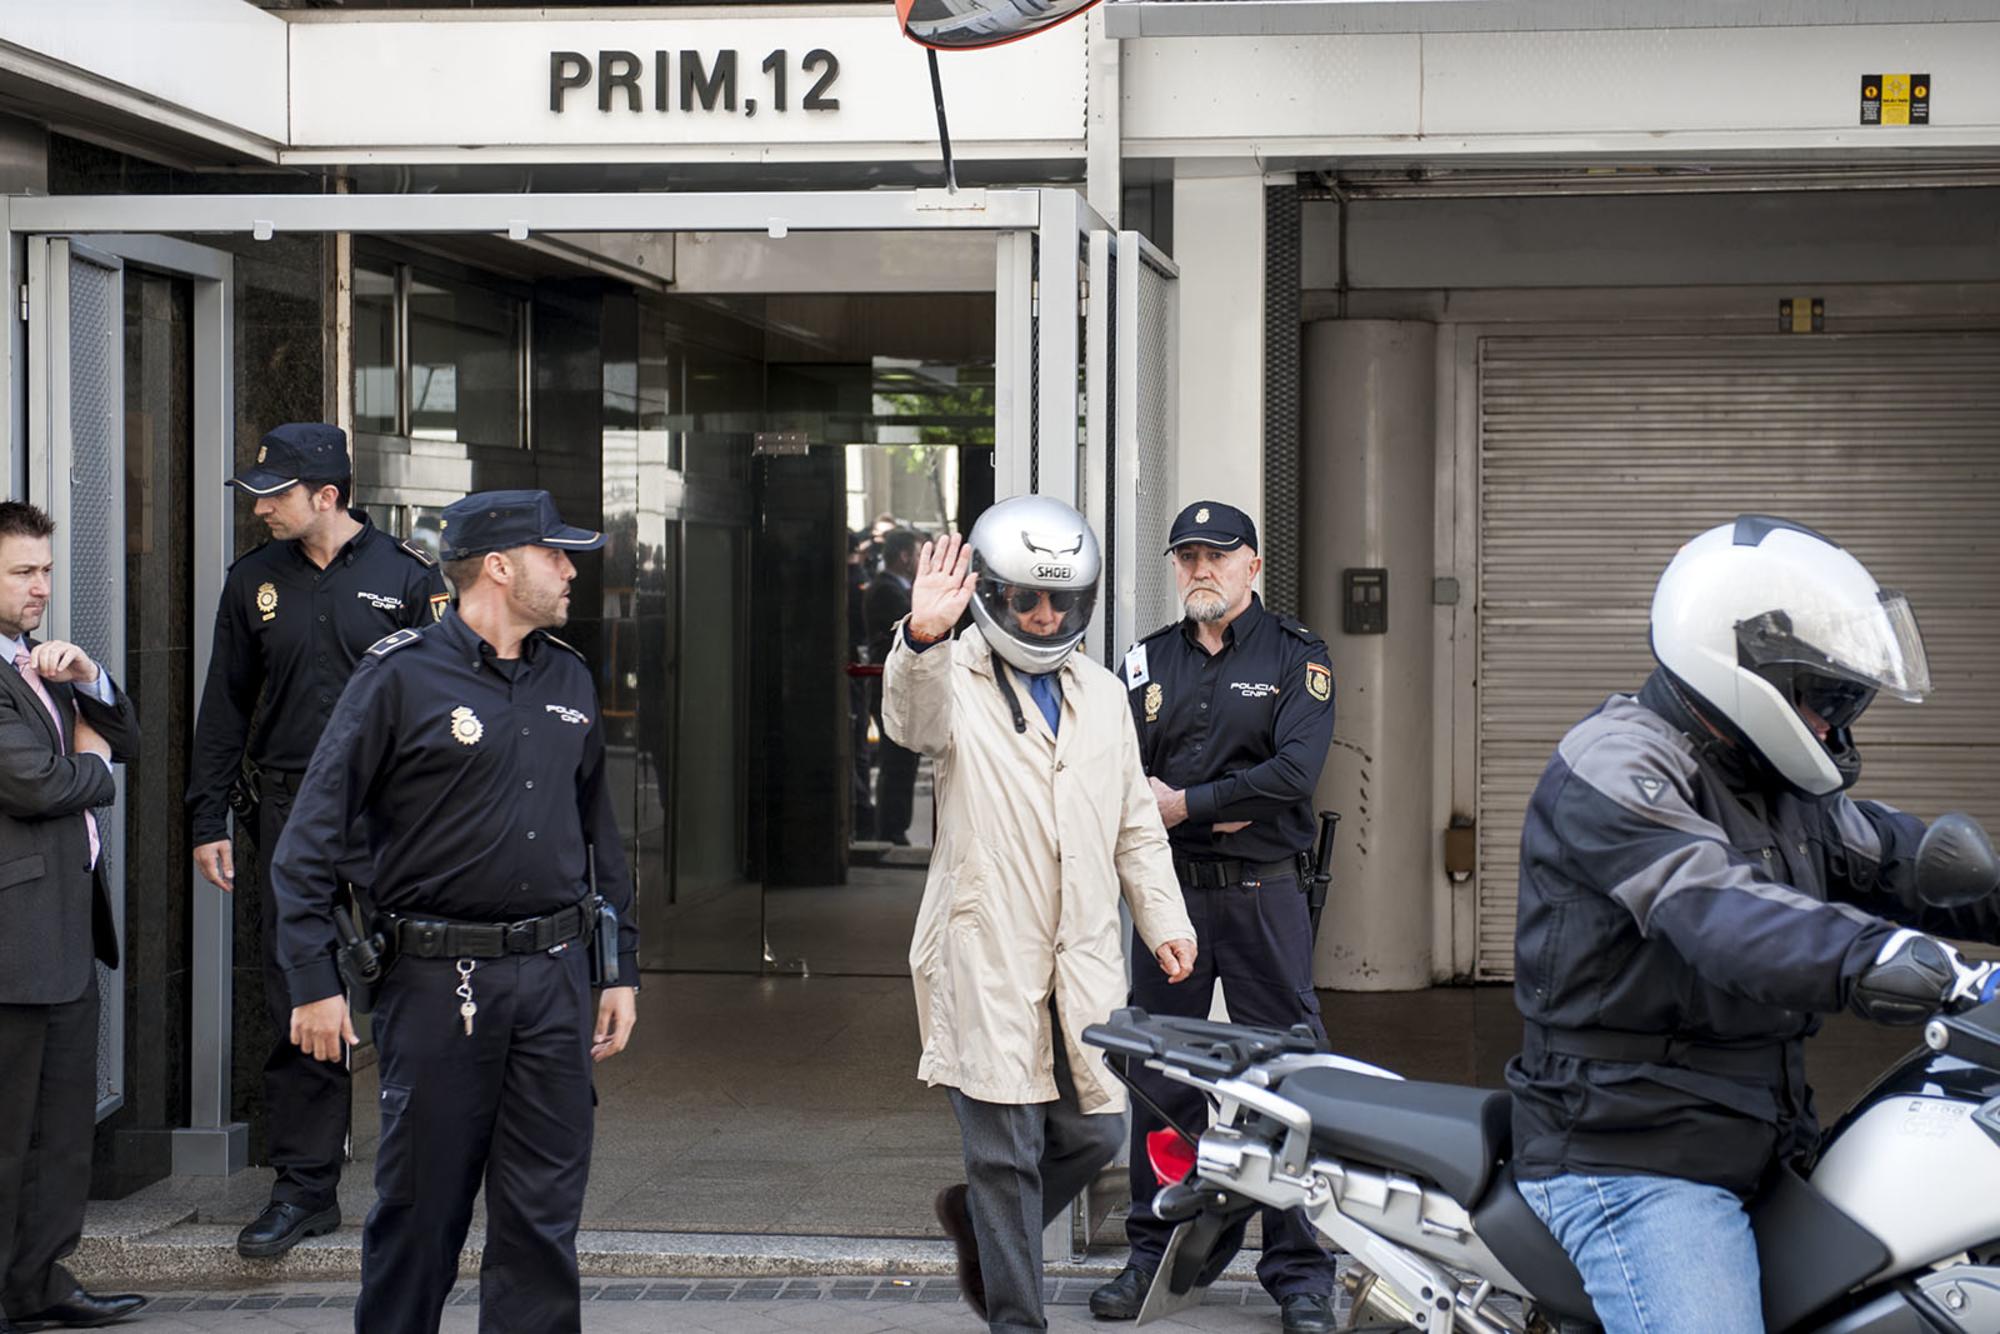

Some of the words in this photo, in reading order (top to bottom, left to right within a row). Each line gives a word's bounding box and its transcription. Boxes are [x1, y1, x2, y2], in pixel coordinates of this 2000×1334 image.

[549, 48, 841, 118] PRIM,12
[1037, 565, 1072, 579] SHOEI
[1230, 682, 1276, 694] POLICIA
[1241, 689, 1268, 697] CNP
